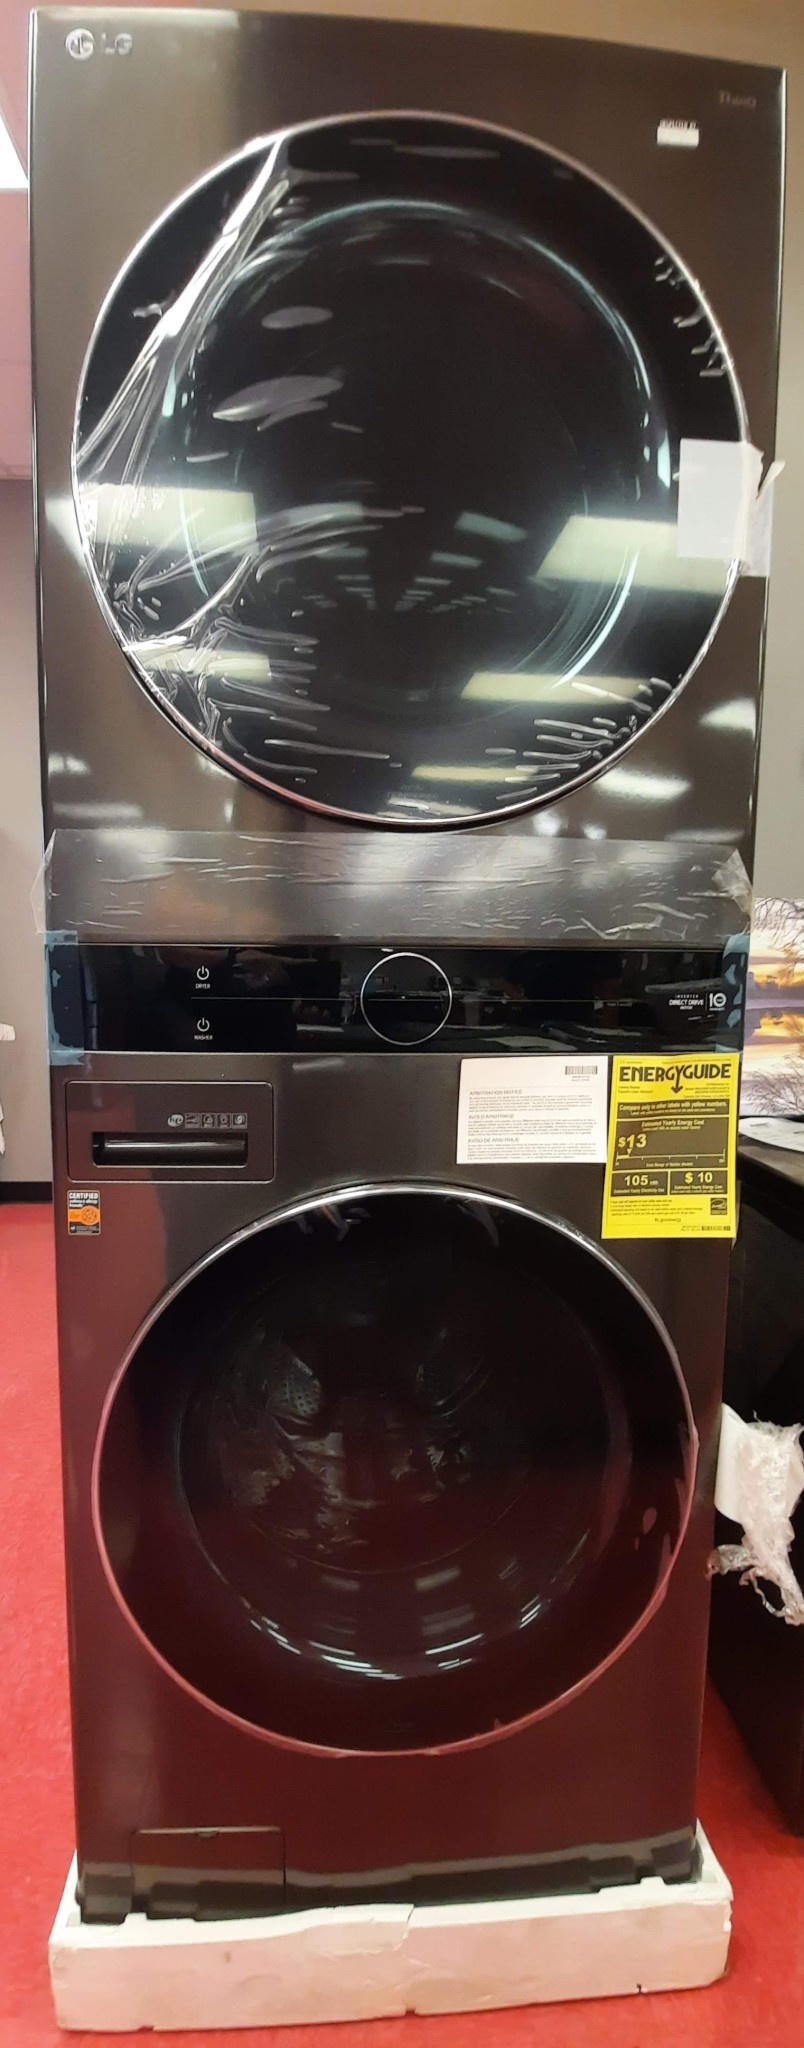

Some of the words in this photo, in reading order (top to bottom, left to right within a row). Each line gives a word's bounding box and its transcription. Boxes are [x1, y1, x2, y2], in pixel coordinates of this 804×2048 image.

[101, 32, 133, 55] LG
[709, 992, 727, 1008] 10
[619, 1063, 732, 1088] ENERGYGUIDE
[618, 1133, 647, 1149] $13
[624, 1174, 649, 1187] 105
[684, 1171, 694, 1184] $
[697, 1171, 713, 1183] 10
[69, 1192, 99, 1200] CERTIFIED
